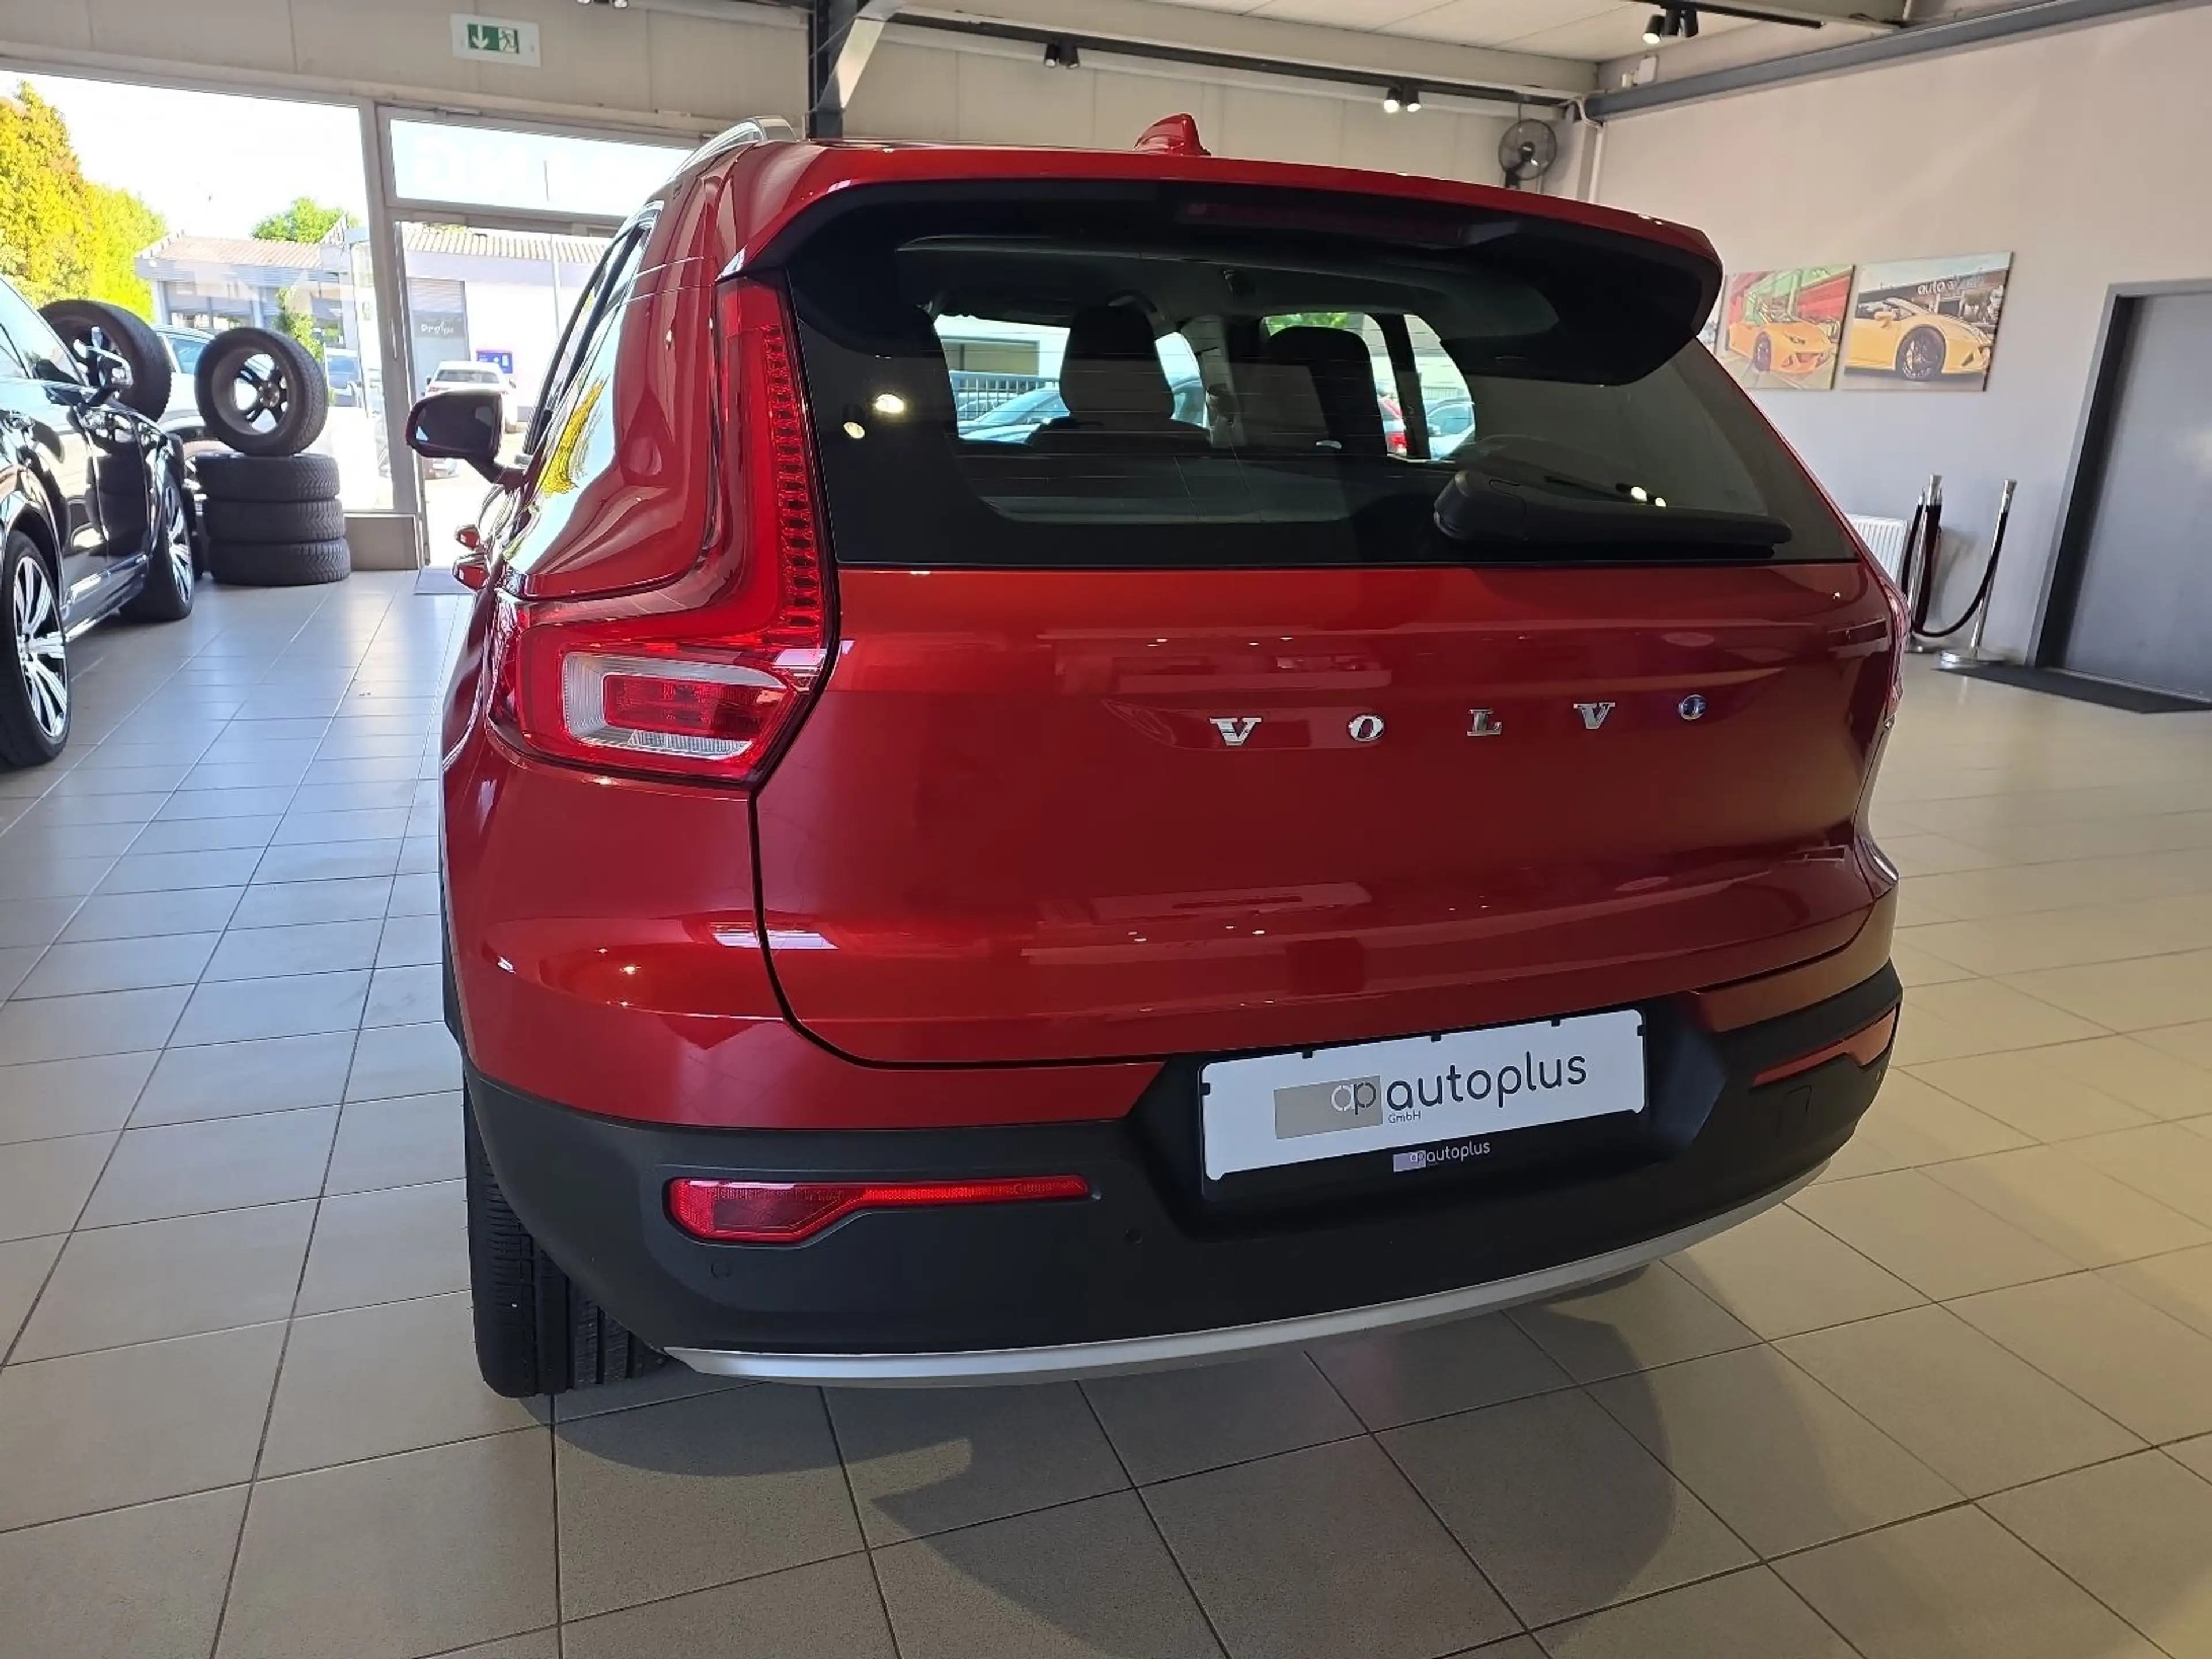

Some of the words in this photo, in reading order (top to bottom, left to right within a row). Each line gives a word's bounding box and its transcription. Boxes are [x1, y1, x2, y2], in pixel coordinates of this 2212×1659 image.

[1209, 694, 1706, 747] VOLVO
[1386, 1051, 1587, 1111] autoplus
[1388, 1111, 1421, 1124] GmbH
[1426, 1140, 1491, 1162] autoplus
